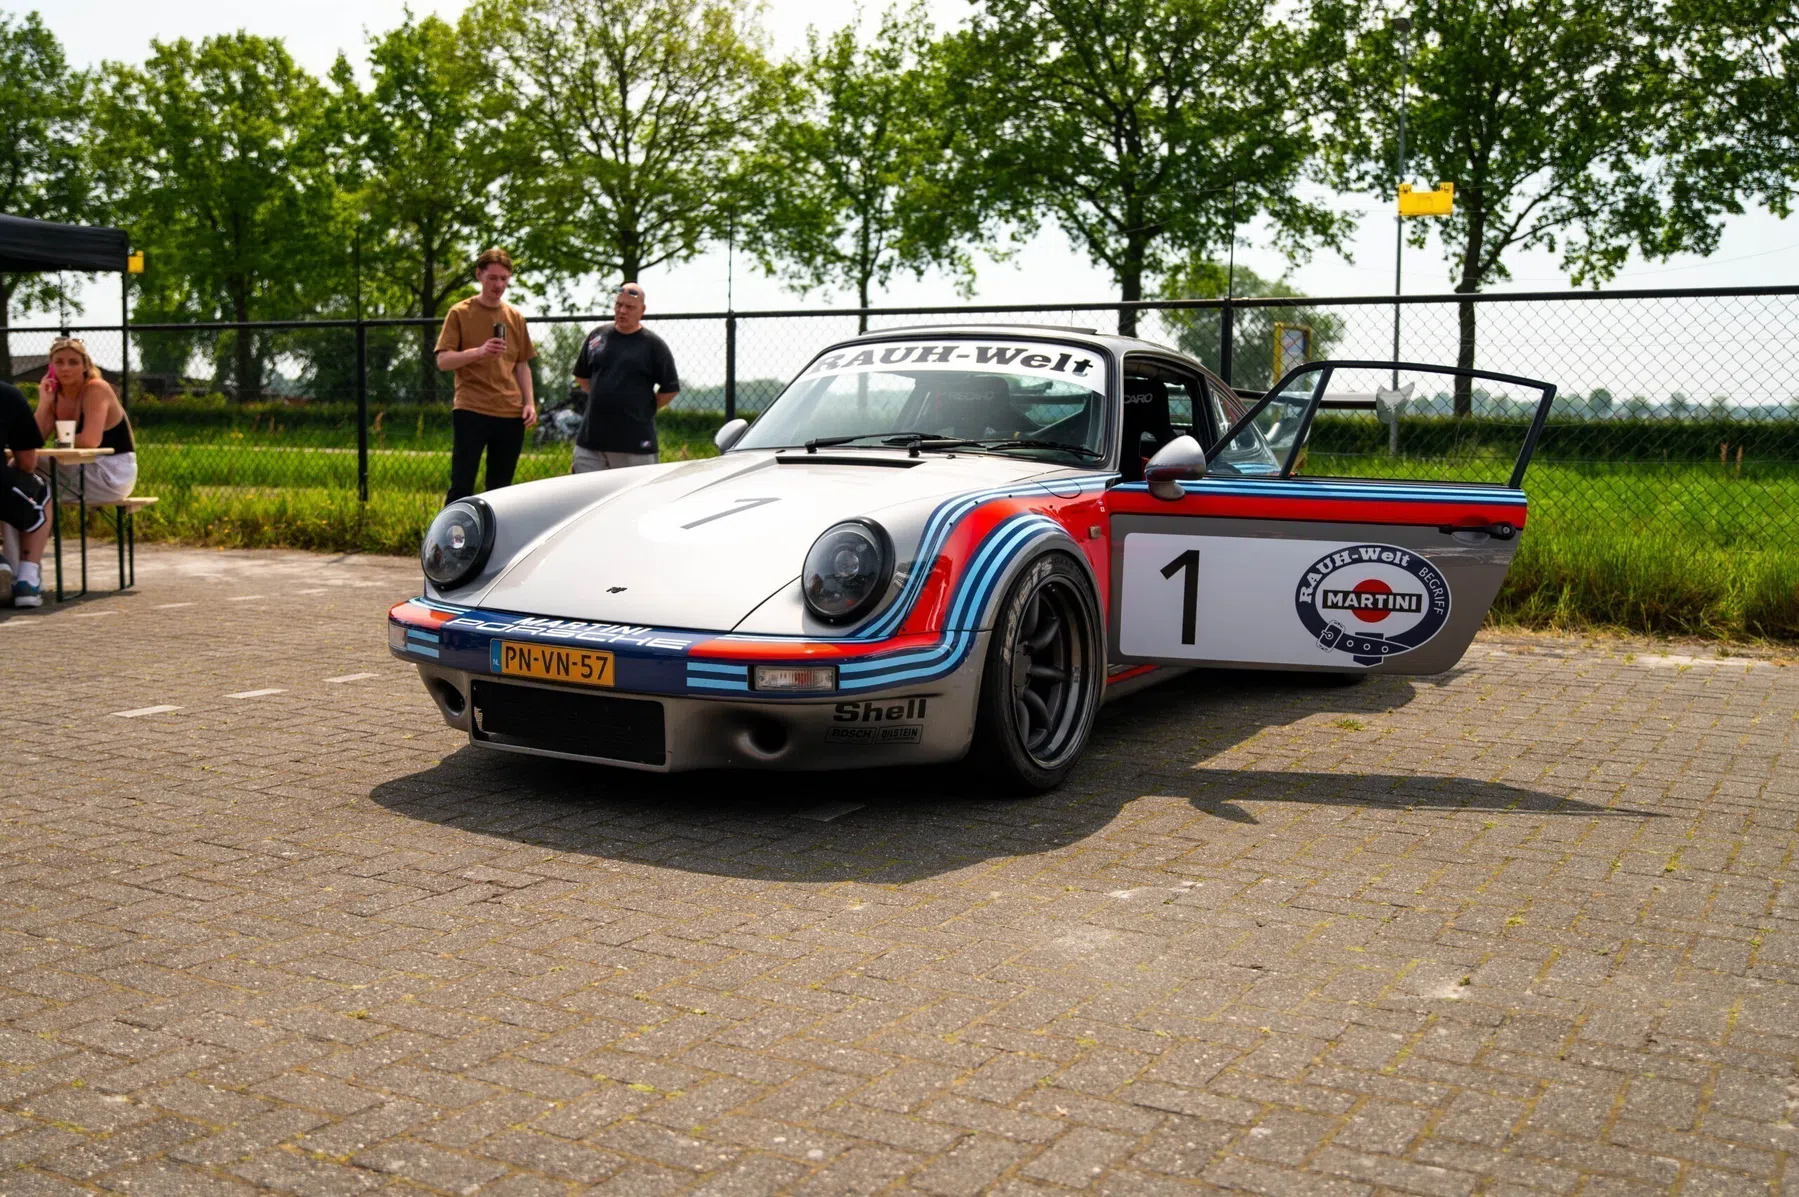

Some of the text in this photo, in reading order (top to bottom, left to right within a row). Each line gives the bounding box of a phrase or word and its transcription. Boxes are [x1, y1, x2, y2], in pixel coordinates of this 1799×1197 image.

[808, 345, 1094, 377] RAUH-Welt
[1298, 547, 1411, 604] RAUH-Welt
[1418, 566, 1445, 616] BEGRIFF
[1160, 549, 1200, 645] 1
[1327, 592, 1417, 610] MARTINI
[446, 617, 693, 651] PORSCHE
[512, 616, 653, 636] MARTINI
[492, 658, 500, 666] NL
[505, 646, 609, 680] PN-VN-57
[833, 699, 927, 722] Shell
[832, 728, 919, 739] BOSCH BILSTEIN
